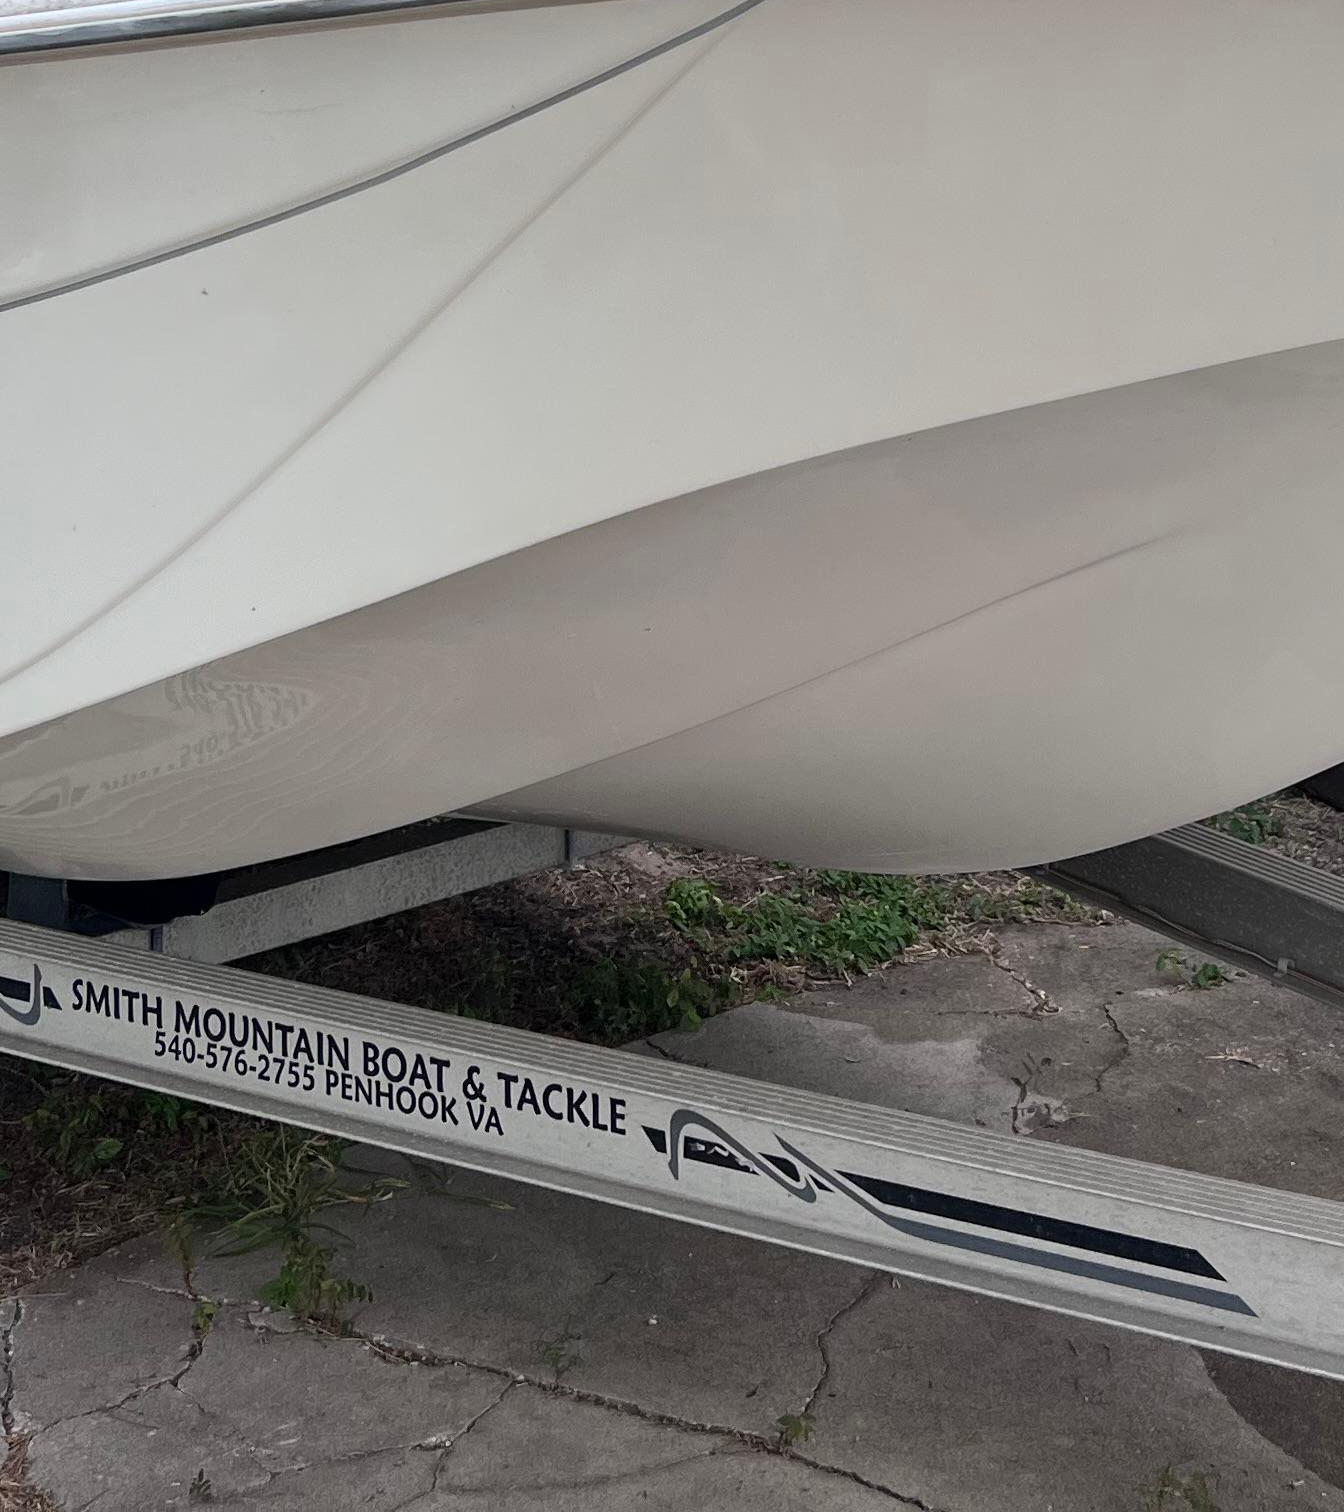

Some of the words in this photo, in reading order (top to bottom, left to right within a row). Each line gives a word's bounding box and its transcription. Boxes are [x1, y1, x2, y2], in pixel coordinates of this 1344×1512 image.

[72, 978, 164, 1029] SMITH
[174, 1000, 350, 1071] MOUNTAIN
[362, 1040, 451, 1093] BOAT
[462, 1065, 487, 1103] &
[497, 1071, 627, 1136] TACKLE
[154, 1030, 316, 1091] 540-576-2755
[325, 1068, 459, 1126] PENHOOK
[466, 1100, 504, 1137] VA
